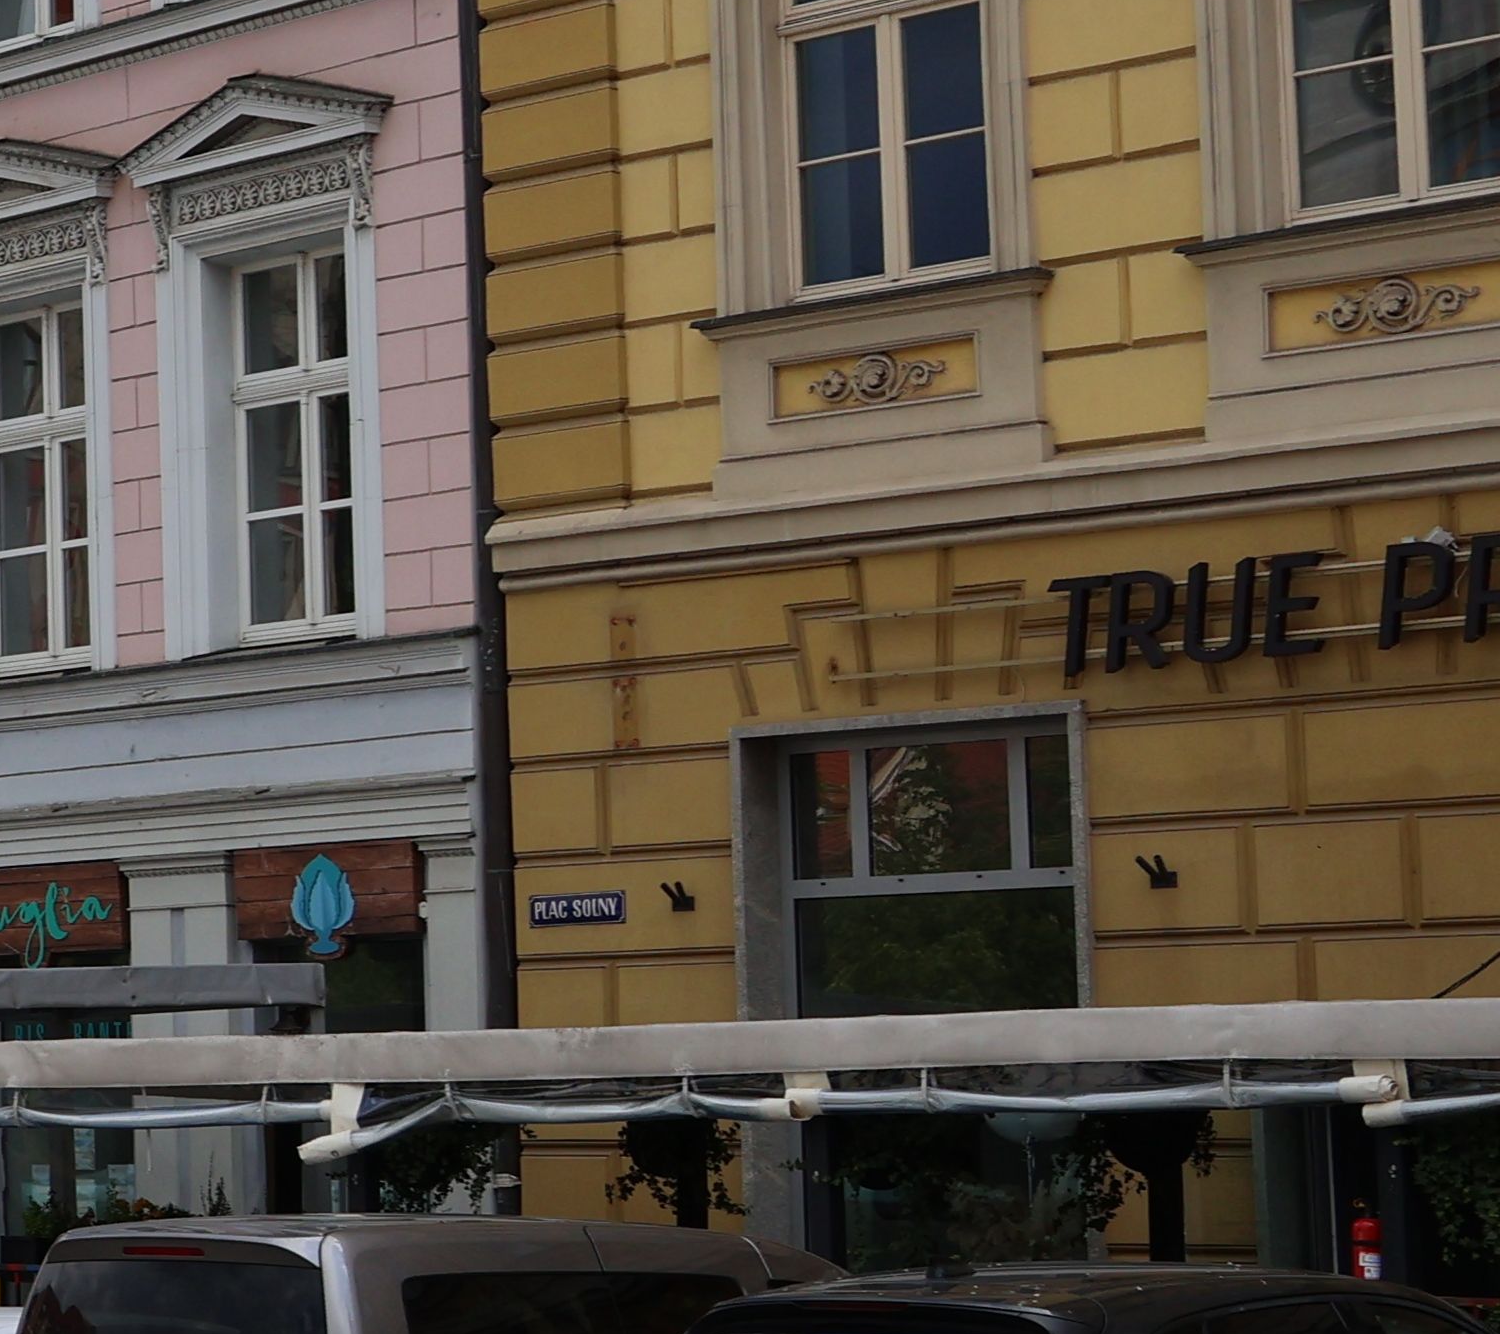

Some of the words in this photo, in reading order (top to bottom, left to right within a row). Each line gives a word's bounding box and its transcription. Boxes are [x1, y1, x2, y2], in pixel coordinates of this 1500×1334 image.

[1047, 553, 1326, 678] TRUE
[534, 901, 568, 920] PLAC
[572, 897, 617, 918] SOLNY
